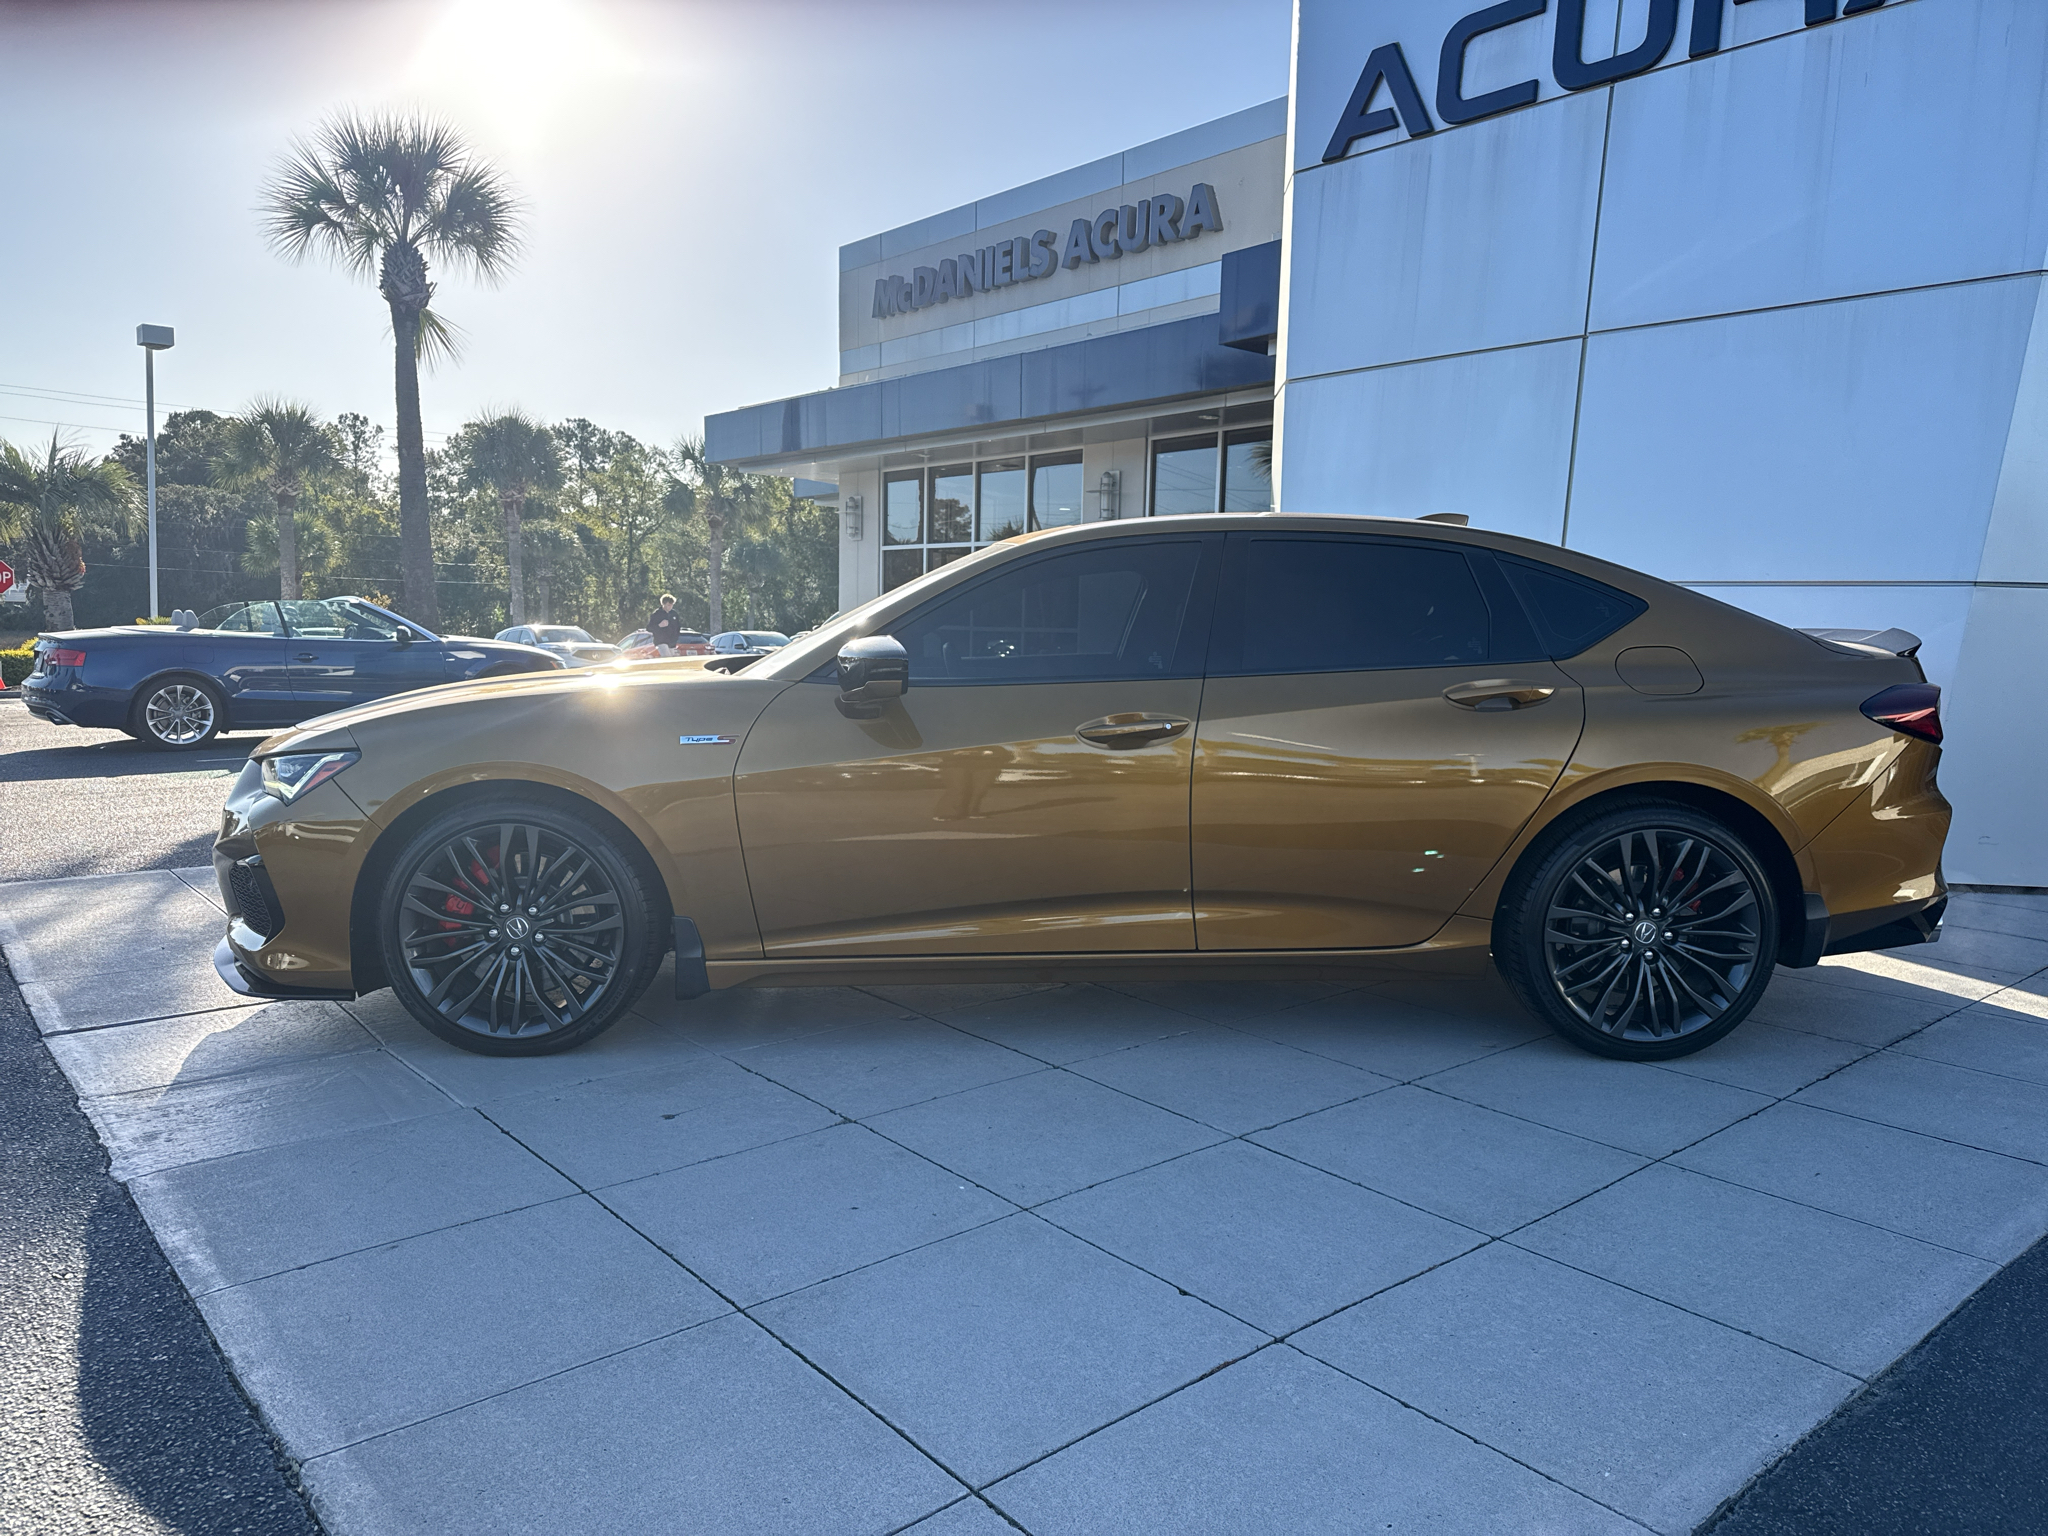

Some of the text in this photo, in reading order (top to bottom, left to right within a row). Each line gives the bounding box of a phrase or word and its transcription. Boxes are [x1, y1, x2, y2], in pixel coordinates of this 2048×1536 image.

[1322, 0, 1886, 163] ACU
[872, 183, 1224, 320] McDANIELS ACURA
